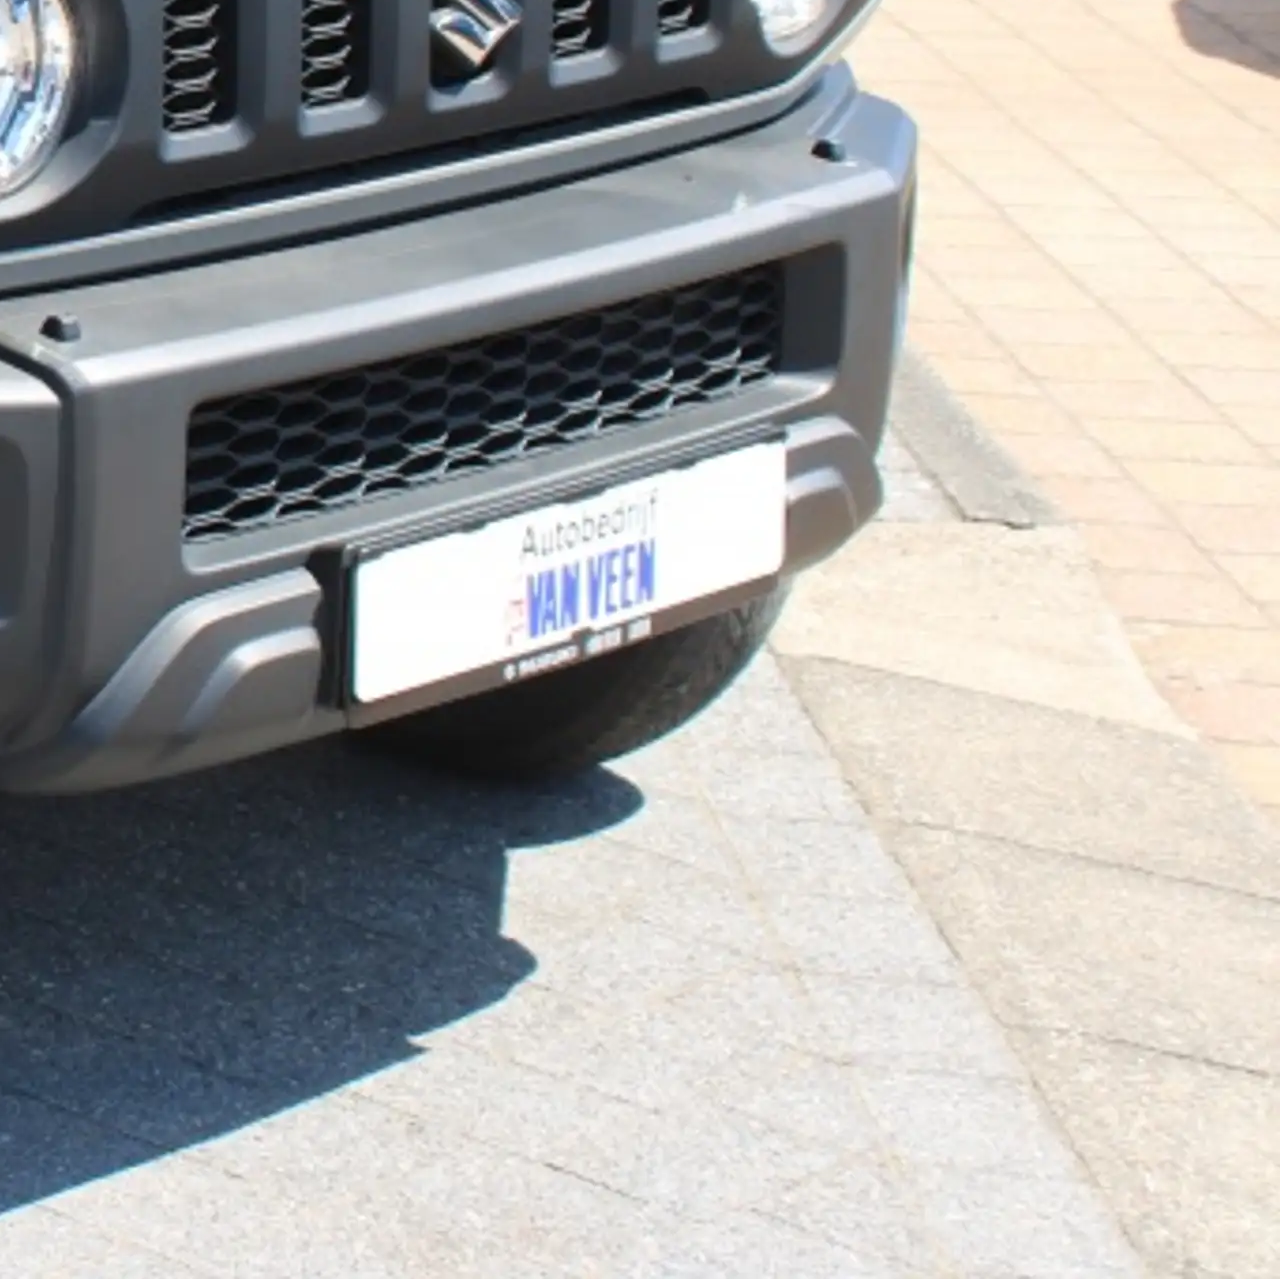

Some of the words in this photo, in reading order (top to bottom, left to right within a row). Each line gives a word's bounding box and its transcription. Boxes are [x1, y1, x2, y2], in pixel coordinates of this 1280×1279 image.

[521, 489, 659, 559] Autobedrijf
[527, 559, 581, 639] VAN
[587, 537, 656, 621] VEEN
